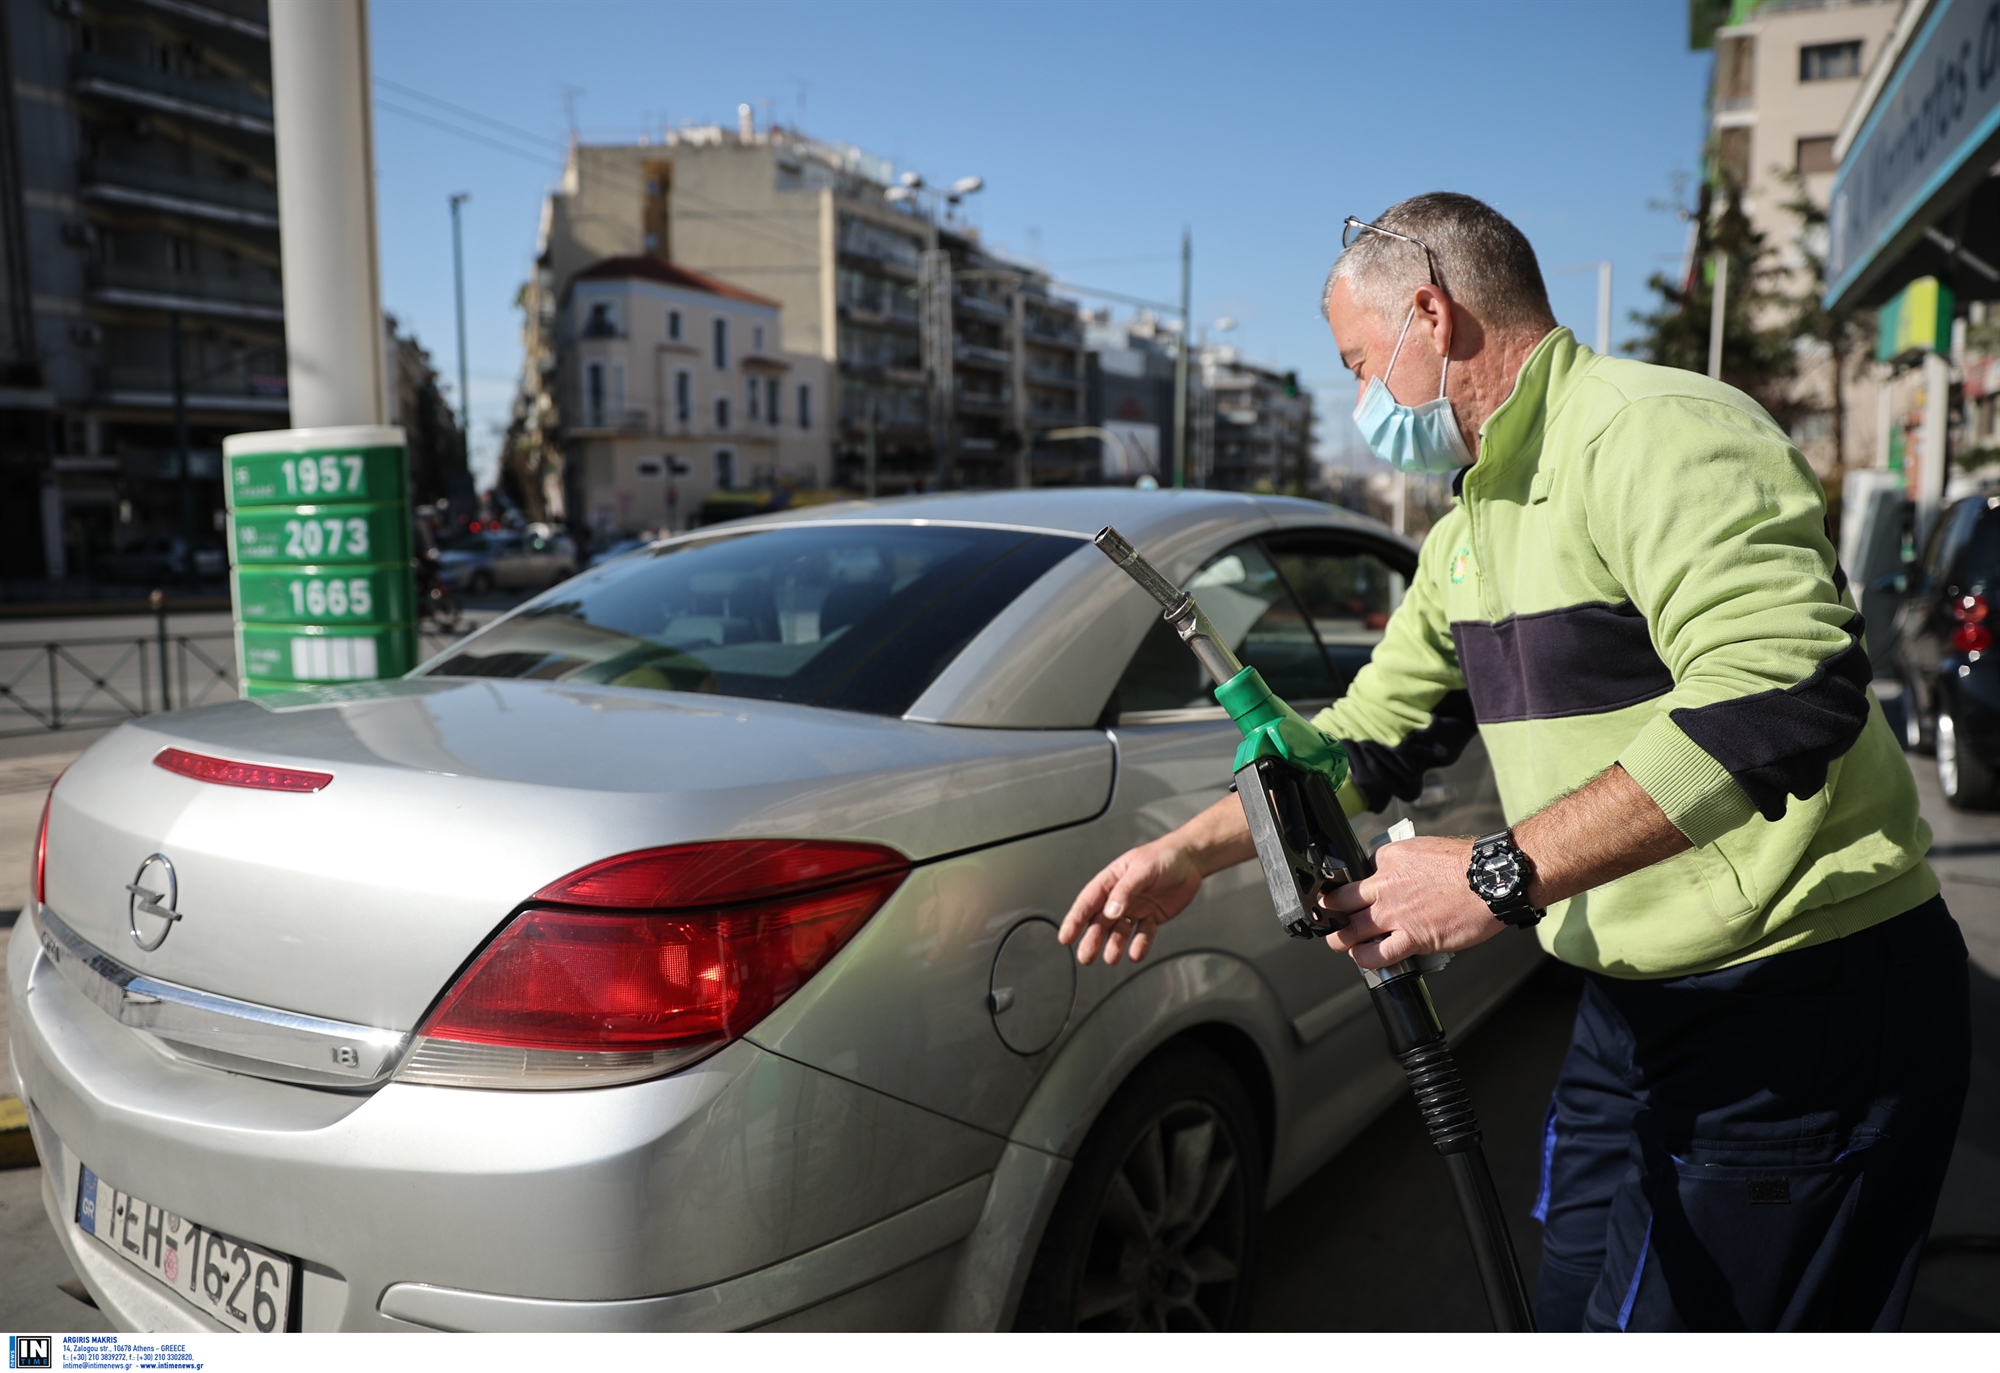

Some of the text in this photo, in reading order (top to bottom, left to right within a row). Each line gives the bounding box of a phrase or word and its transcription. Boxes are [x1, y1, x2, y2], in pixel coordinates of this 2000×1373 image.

[282, 455, 364, 495] 1957
[284, 518, 370, 558] 2073
[289, 578, 372, 616] 1665
[82, 1197, 95, 1220] GR
